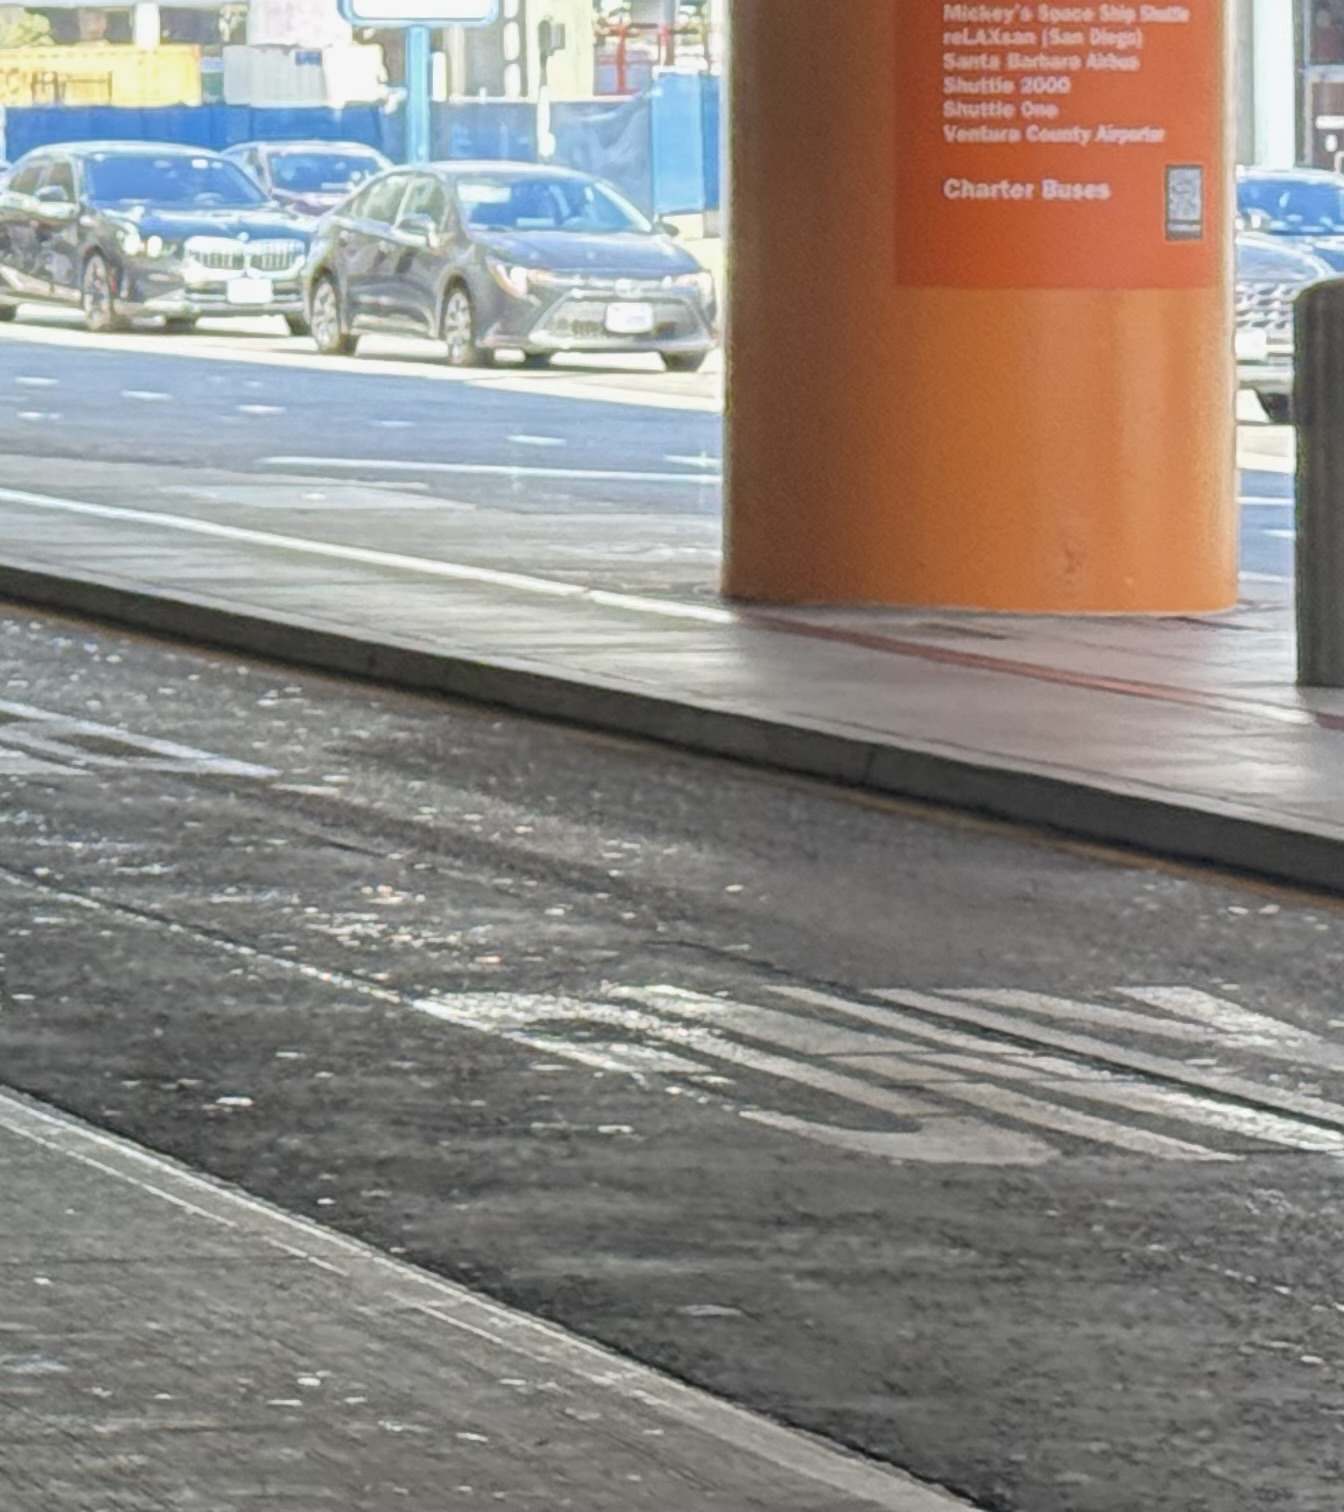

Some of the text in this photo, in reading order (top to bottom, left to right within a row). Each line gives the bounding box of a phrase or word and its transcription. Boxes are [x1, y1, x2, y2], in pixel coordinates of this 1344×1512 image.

[1037, 5, 1095, 25] Space
[944, 53, 1001, 71] Santa
[1007, 53, 1082, 71] Barbara
[944, 76, 1072, 95] Shuttle 2000
[944, 100, 1060, 119] Shuttle One
[944, 124, 1021, 143] Ventura
[1025, 124, 1092, 147] County
[943, 178, 1110, 201] Charter Buses
